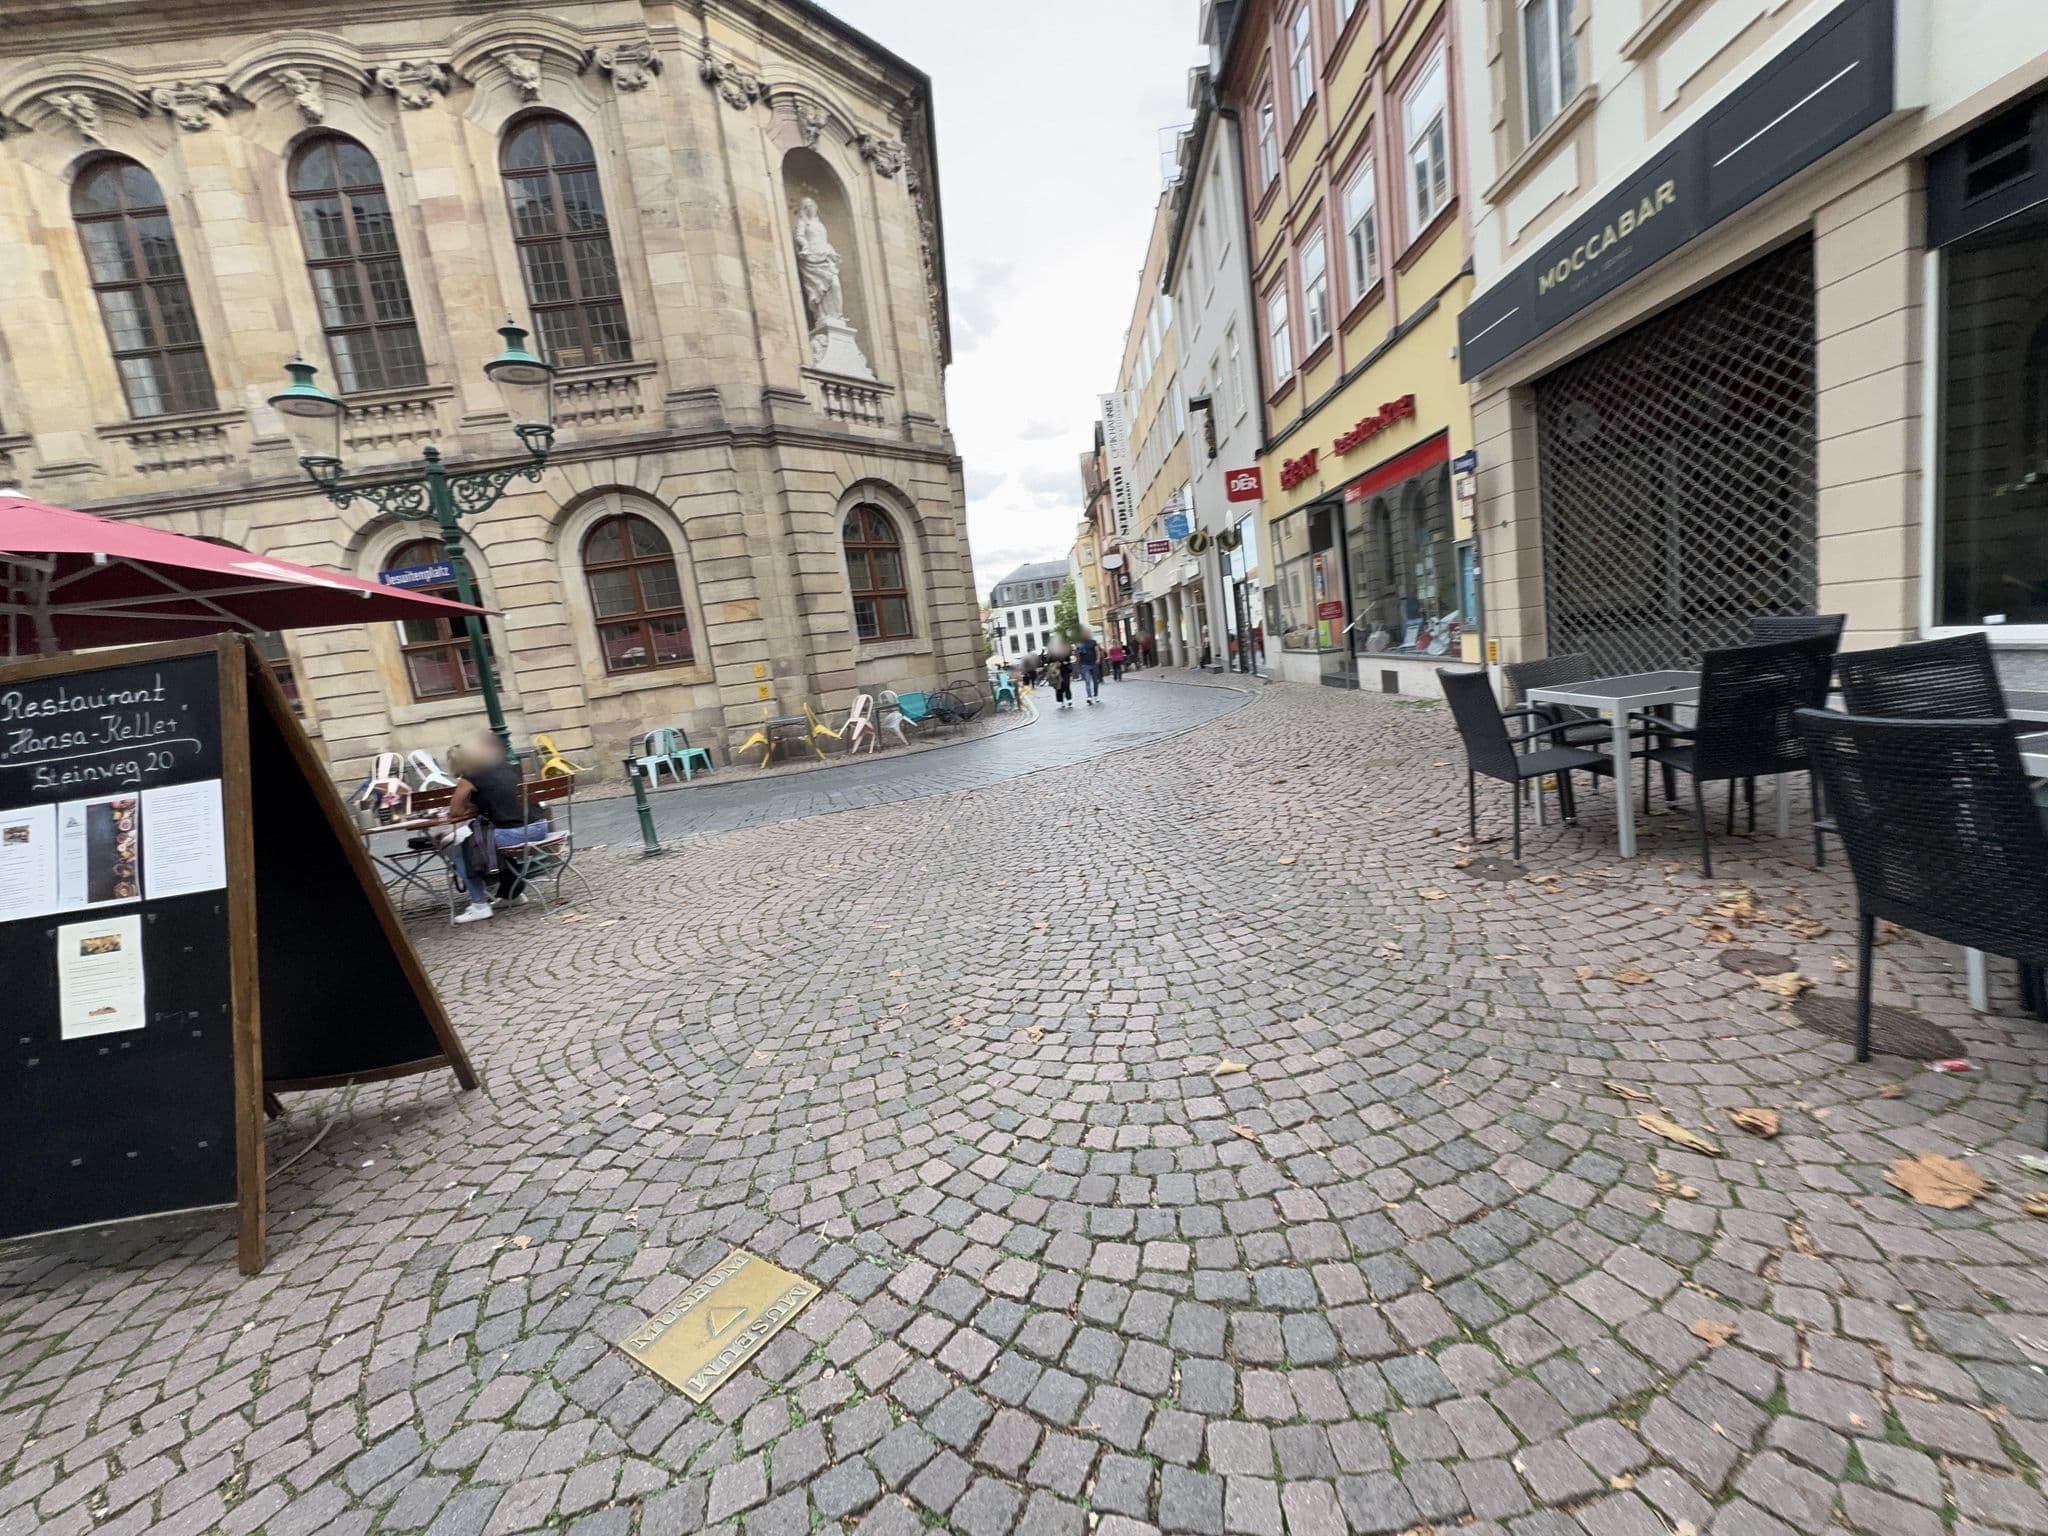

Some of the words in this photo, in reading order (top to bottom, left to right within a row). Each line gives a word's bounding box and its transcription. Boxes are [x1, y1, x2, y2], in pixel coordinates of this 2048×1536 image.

[1538, 179, 1676, 295] MOCCABAR
[385, 566, 450, 585] Jesuitenplatz
[0, 672, 166, 722] Restaurant
[32, 761, 142, 791] Steinweg
[144, 751, 175, 772] 20
[630, 1255, 750, 1350] MUSEUM
[687, 1284, 810, 1392] MUSEUM
